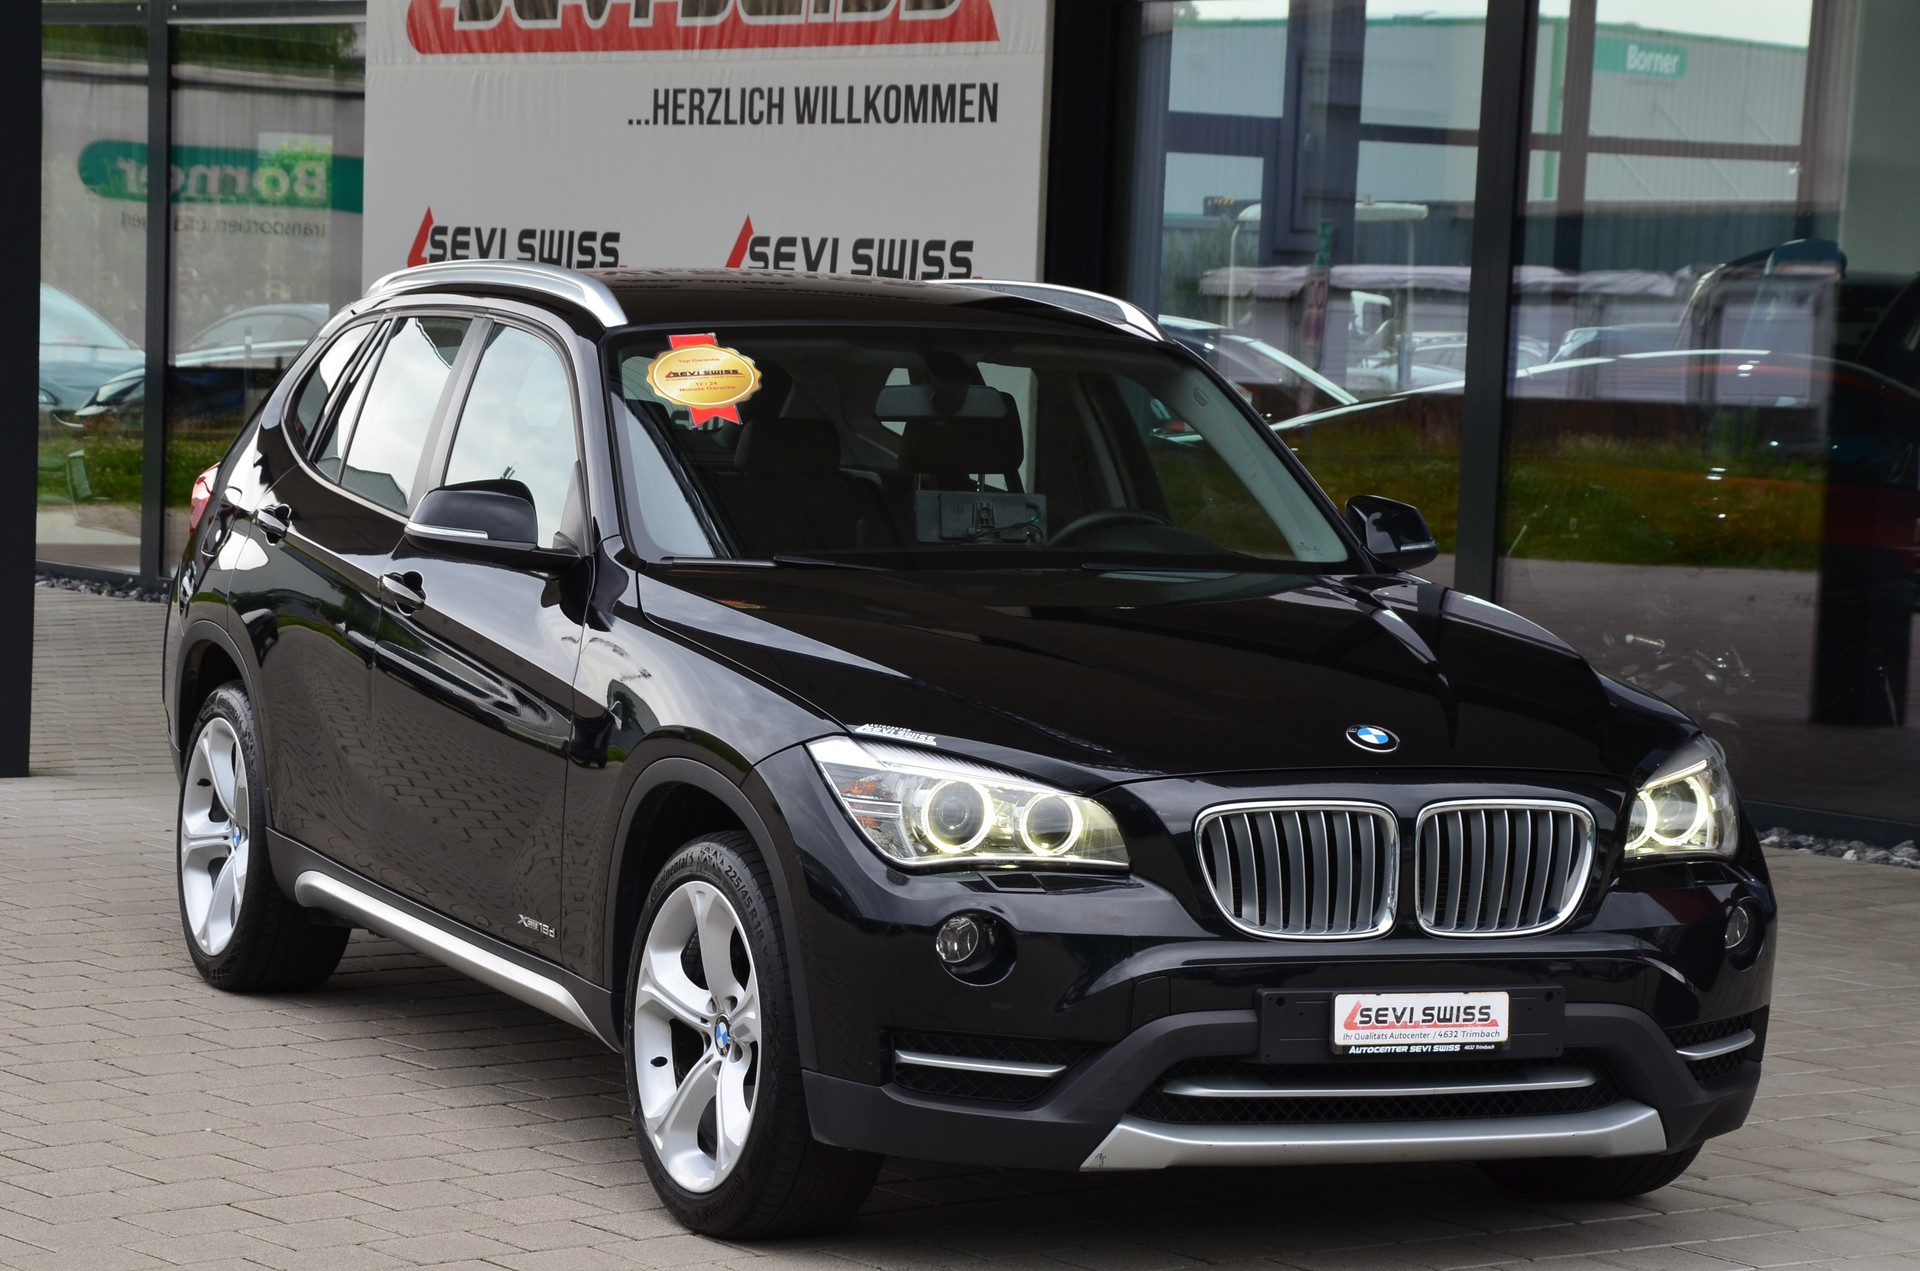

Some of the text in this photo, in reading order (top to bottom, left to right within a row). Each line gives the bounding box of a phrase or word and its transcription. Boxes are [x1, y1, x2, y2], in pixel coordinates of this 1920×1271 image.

[1626, 44, 1680, 74] Borner
[794, 82, 999, 125] WILLKOMMEN
[428, 225, 621, 270] SEVI SWISS
[748, 235, 975, 280] SEVI SWISS
[862, 726, 936, 743] SEVI SWISS
[1358, 1005, 1492, 1025] SEVI SWISS
[1343, 1032, 1353, 1041] Ihr
[1389, 1031, 1430, 1040] Autocenter
[1437, 1030, 1459, 1038] 4632
[1461, 1029, 1500, 1038] Trimbach
[1409, 1044, 1431, 1053] SEVI
[1432, 1044, 1461, 1053] SWISS
